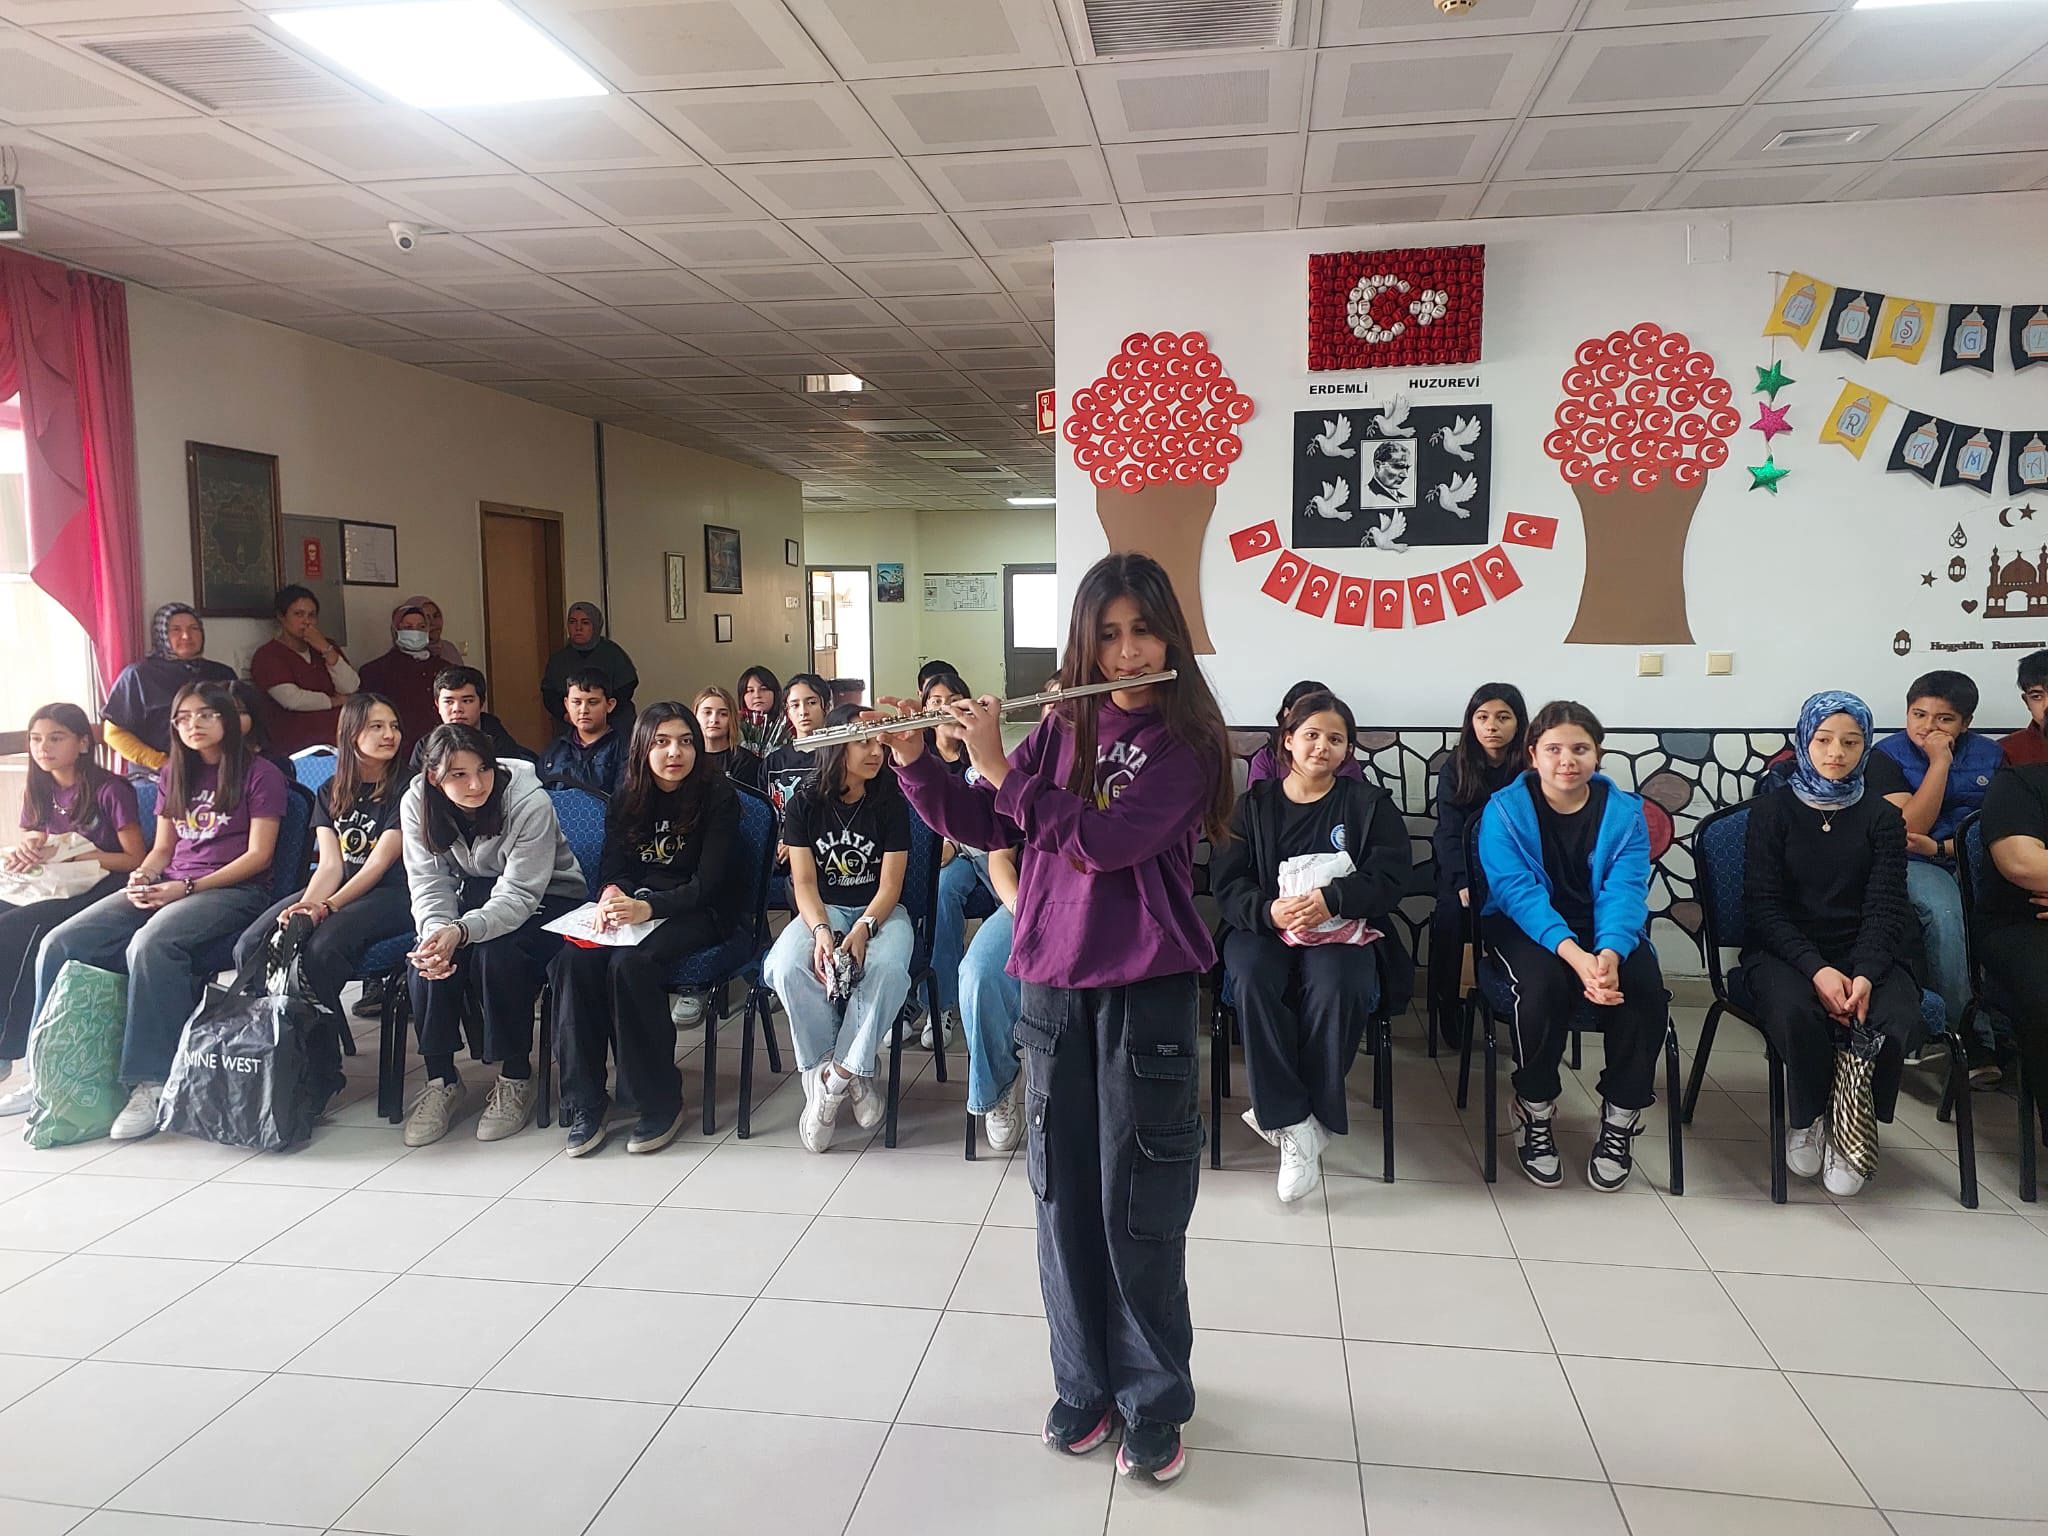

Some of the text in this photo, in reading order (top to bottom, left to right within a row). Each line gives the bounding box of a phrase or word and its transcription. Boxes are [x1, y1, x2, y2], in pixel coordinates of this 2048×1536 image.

[1308, 375, 1481, 395] ERDEMLİ HUZUREVİ
[1096, 741, 1148, 775] LATA
[338, 810, 377, 834] LATA
[816, 829, 875, 857] ALATA
[847, 858, 860, 868] 67
[184, 1049, 262, 1074] NINE WEST
